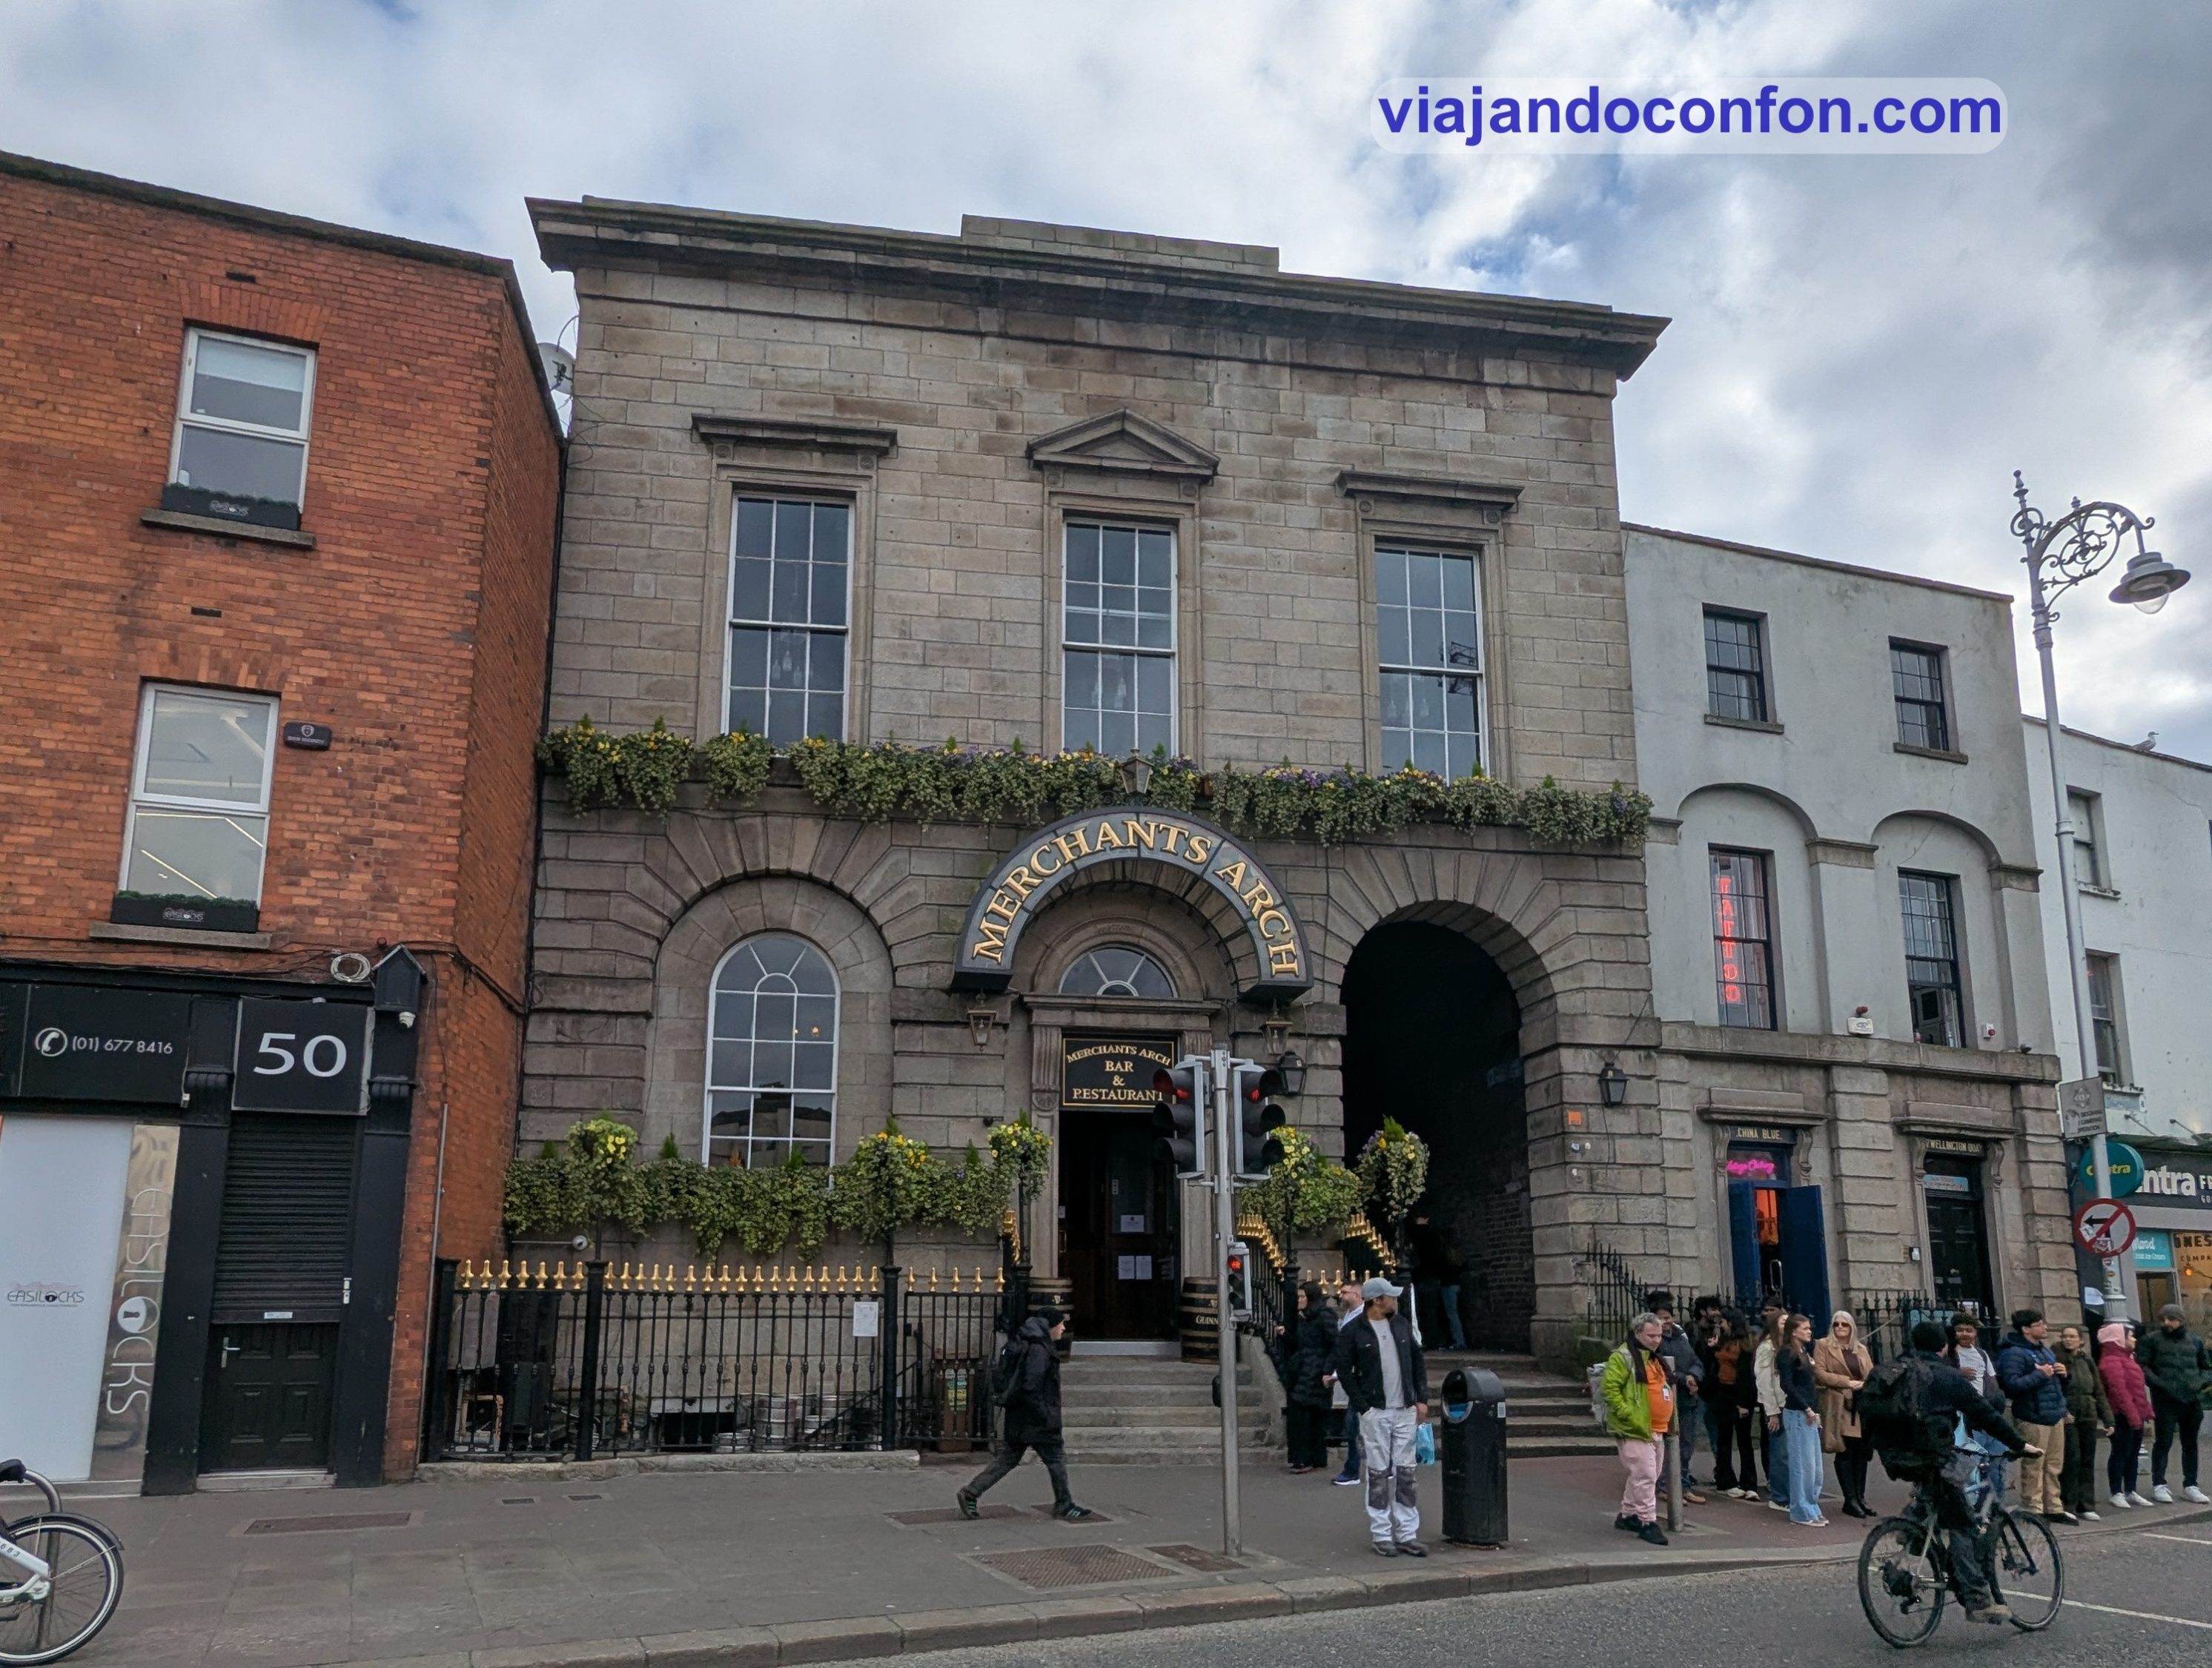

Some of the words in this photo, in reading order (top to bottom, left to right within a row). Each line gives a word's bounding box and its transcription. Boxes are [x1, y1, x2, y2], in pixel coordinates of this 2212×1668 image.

[973, 819, 1212, 964] MERCHANTS
[1213, 860, 1299, 978] ARCH
[73, 1036, 99, 1053] (01)
[105, 1039, 134, 1052] 677
[136, 1041, 173, 1054] 8416
[253, 1032, 348, 1078] 50
[1066, 1045, 1137, 1063] MERCHANTS
[1139, 1048, 1171, 1066] ARCH
[1105, 1060, 1134, 1072] BAR
[1112, 1074, 1125, 1086] &
[2135, 1165, 2196, 1197] ntra
[7, 1290, 85, 1303] EASILOCKS
[106, 1188, 171, 1414] EASILOCKS
[1196, 1314, 1219, 1325] GUINN
